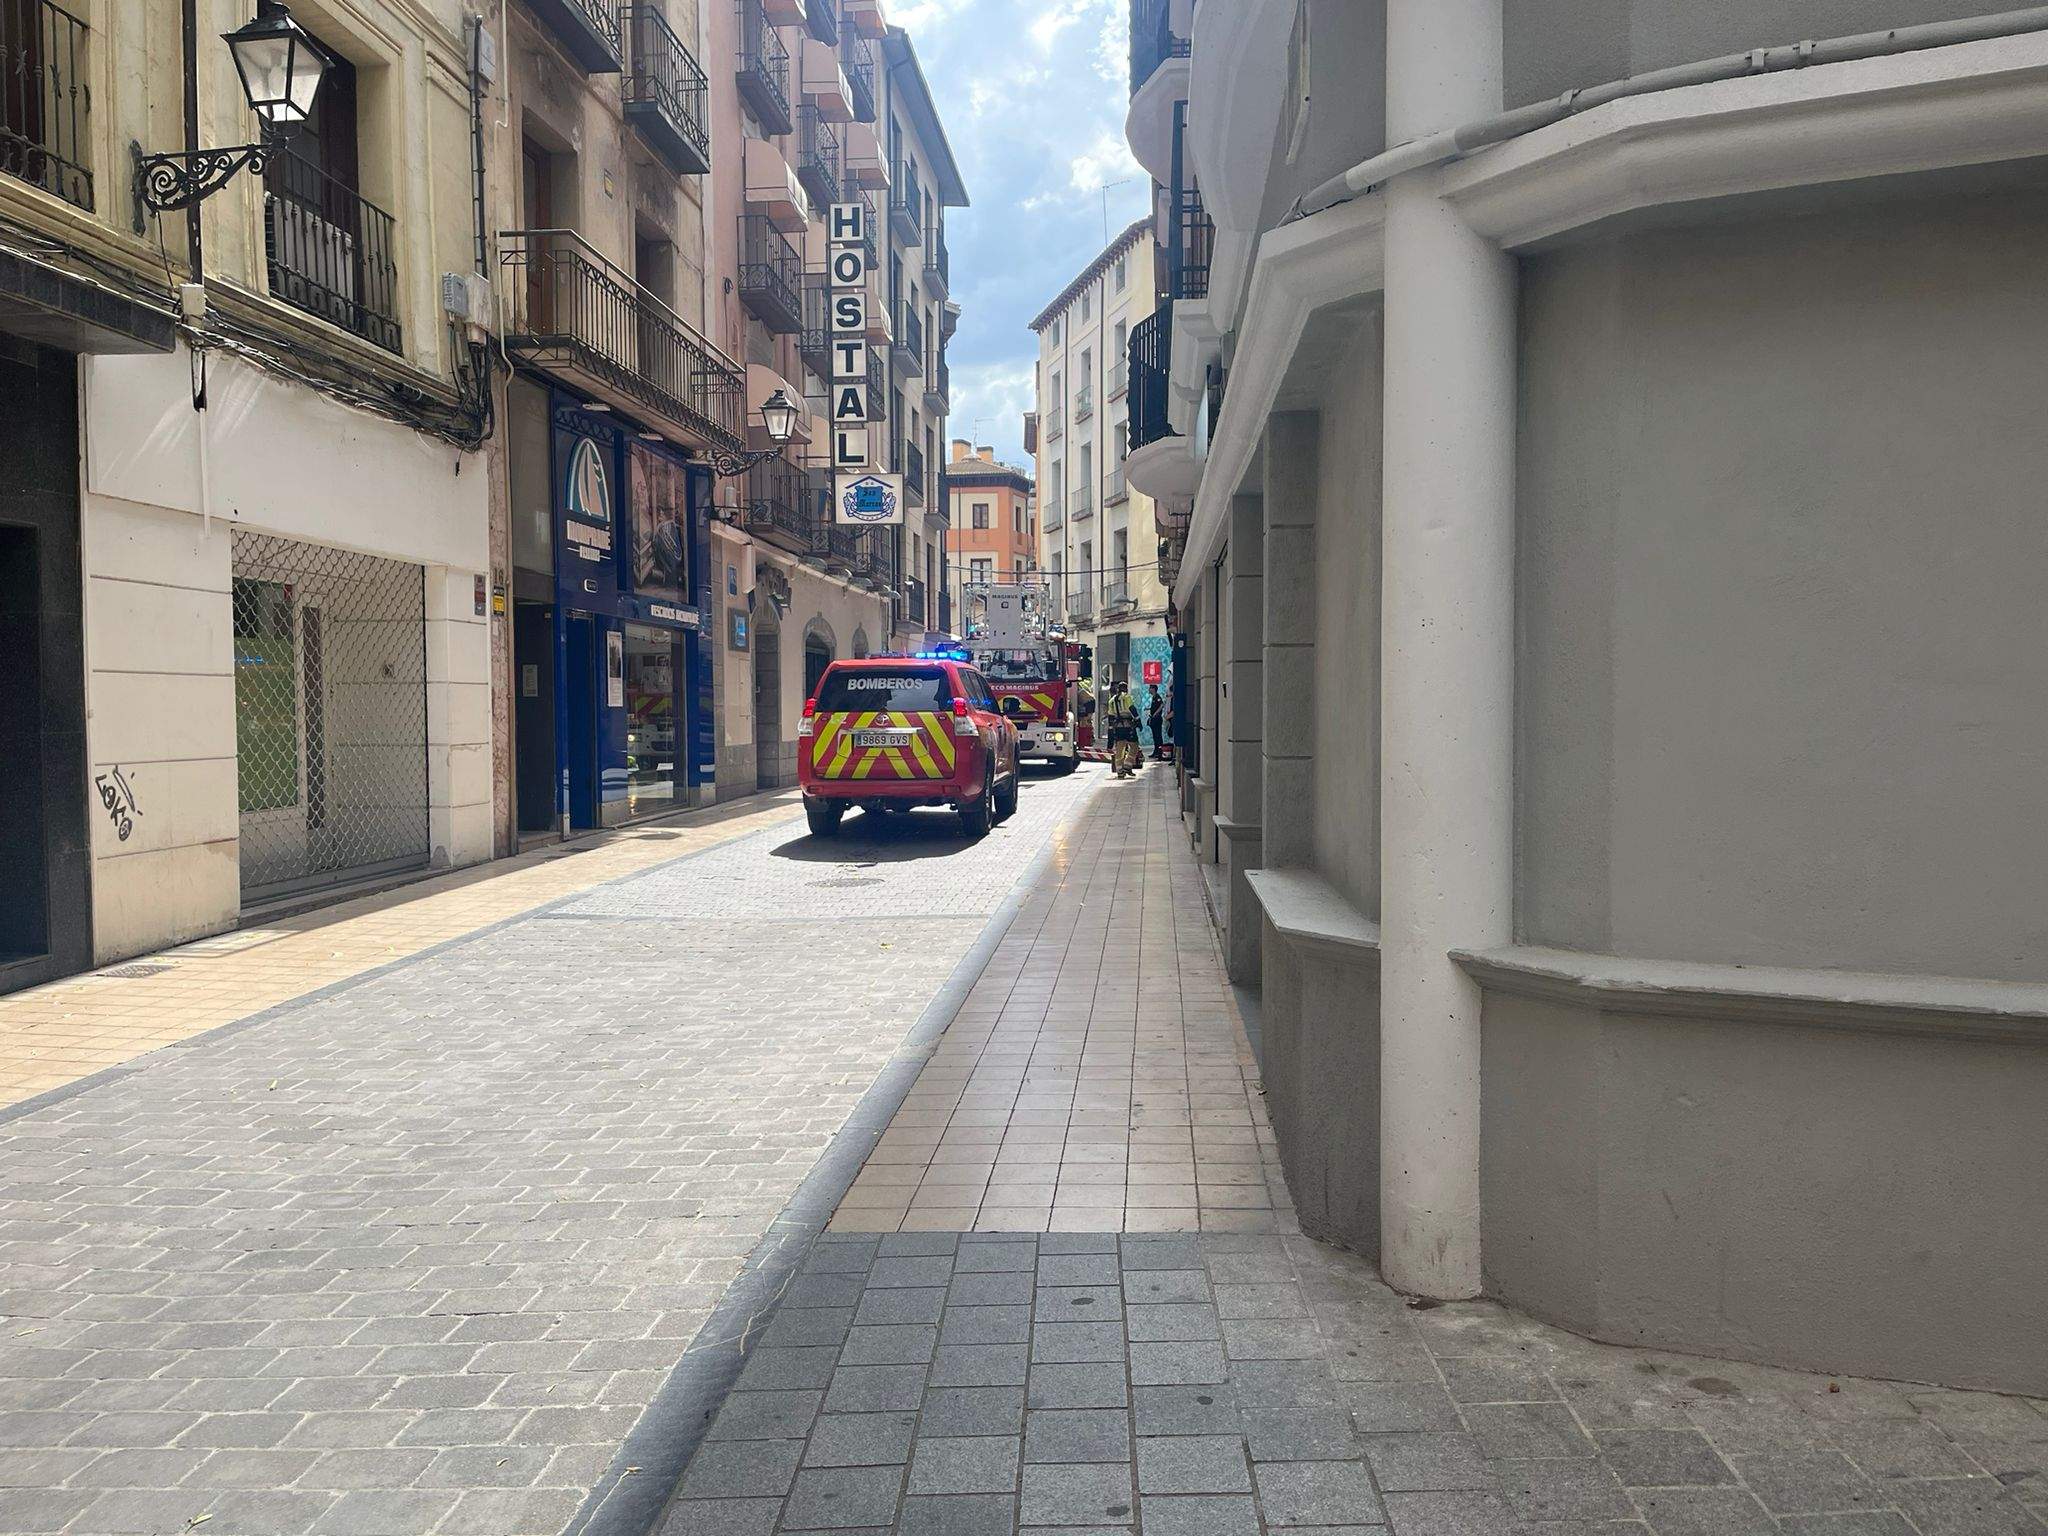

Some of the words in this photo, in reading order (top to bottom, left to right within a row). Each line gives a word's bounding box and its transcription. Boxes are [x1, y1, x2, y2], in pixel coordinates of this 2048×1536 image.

[834, 206, 865, 464] HOSTAL
[847, 677, 923, 691] BOMBEROS
[862, 735, 887, 745] 9869
[889, 735, 908, 745] GVS
